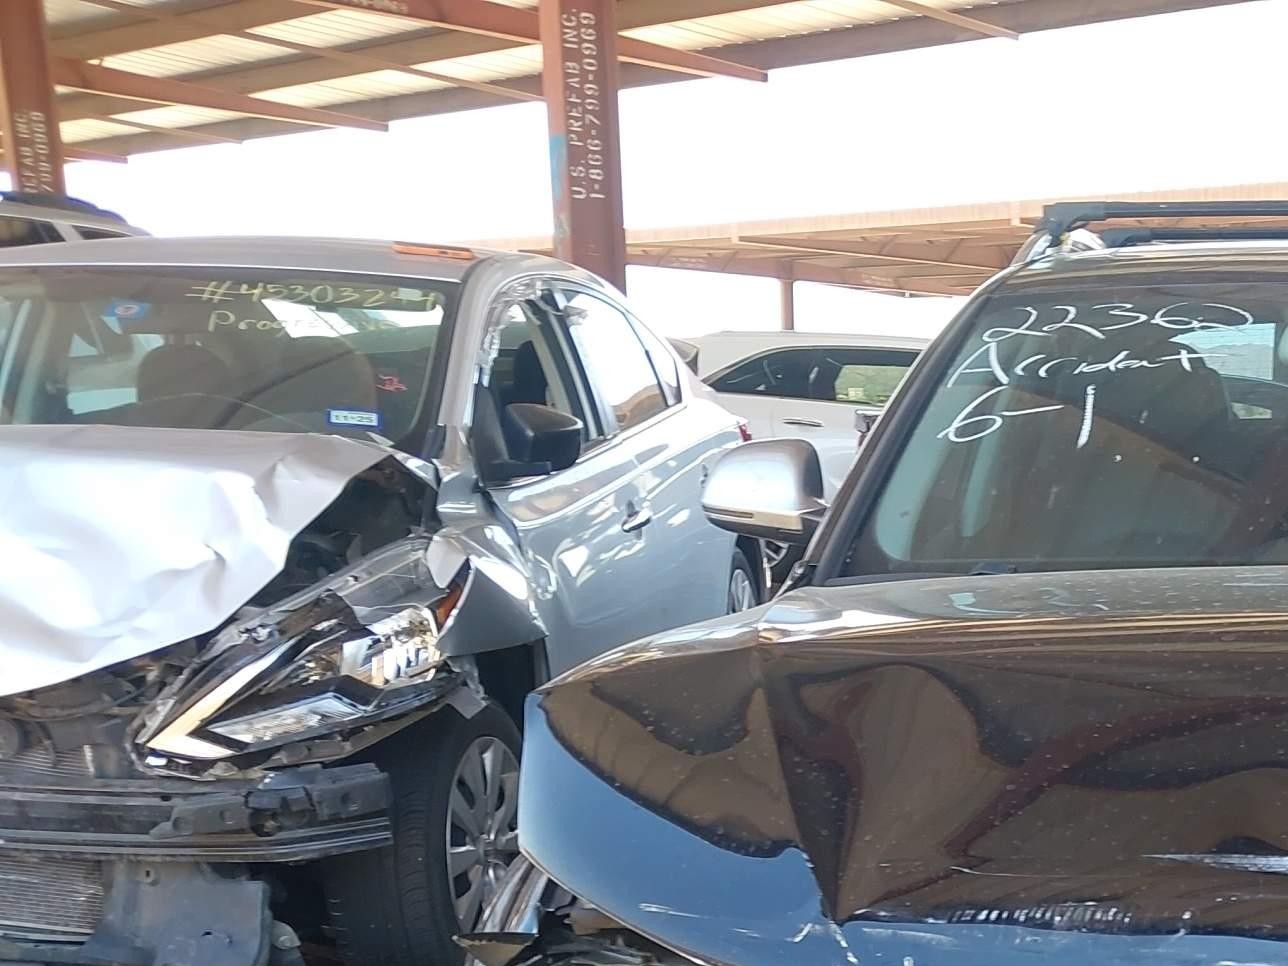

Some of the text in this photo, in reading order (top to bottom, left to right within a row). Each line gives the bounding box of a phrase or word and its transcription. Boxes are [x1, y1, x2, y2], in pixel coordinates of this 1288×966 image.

[561, 8, 580, 49] INC.
[564, 62, 586, 146] PREFAB
[579, 11, 606, 199] 1-866-799-0969
